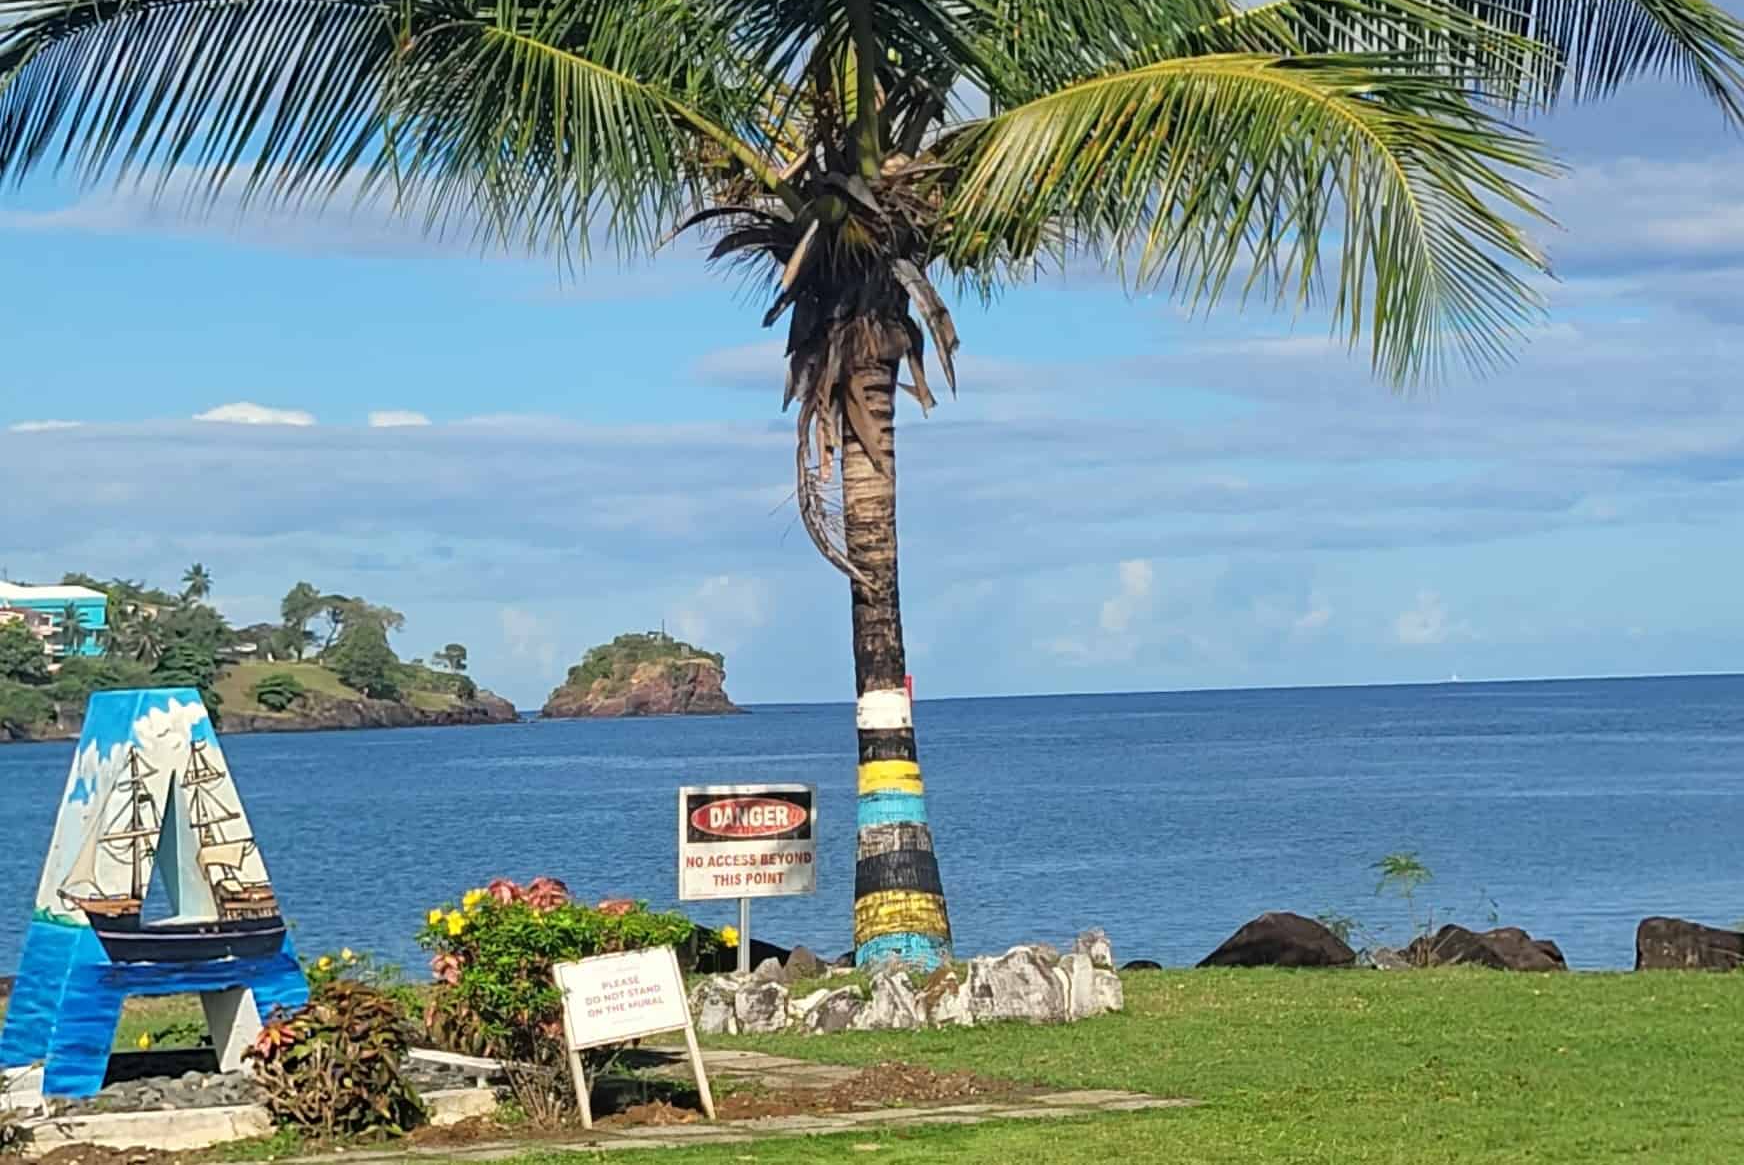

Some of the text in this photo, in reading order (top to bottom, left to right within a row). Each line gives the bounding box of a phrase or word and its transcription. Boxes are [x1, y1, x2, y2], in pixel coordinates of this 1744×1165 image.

[709, 805, 788, 828] DANGER
[686, 851, 812, 868] NO ACCESS BEYOND
[713, 871, 785, 887] THIS POINT
[601, 975, 640, 990] PLEASE
[585, 984, 661, 1006] DO NOT STAND
[587, 997, 664, 1018] ON THE MURAL
